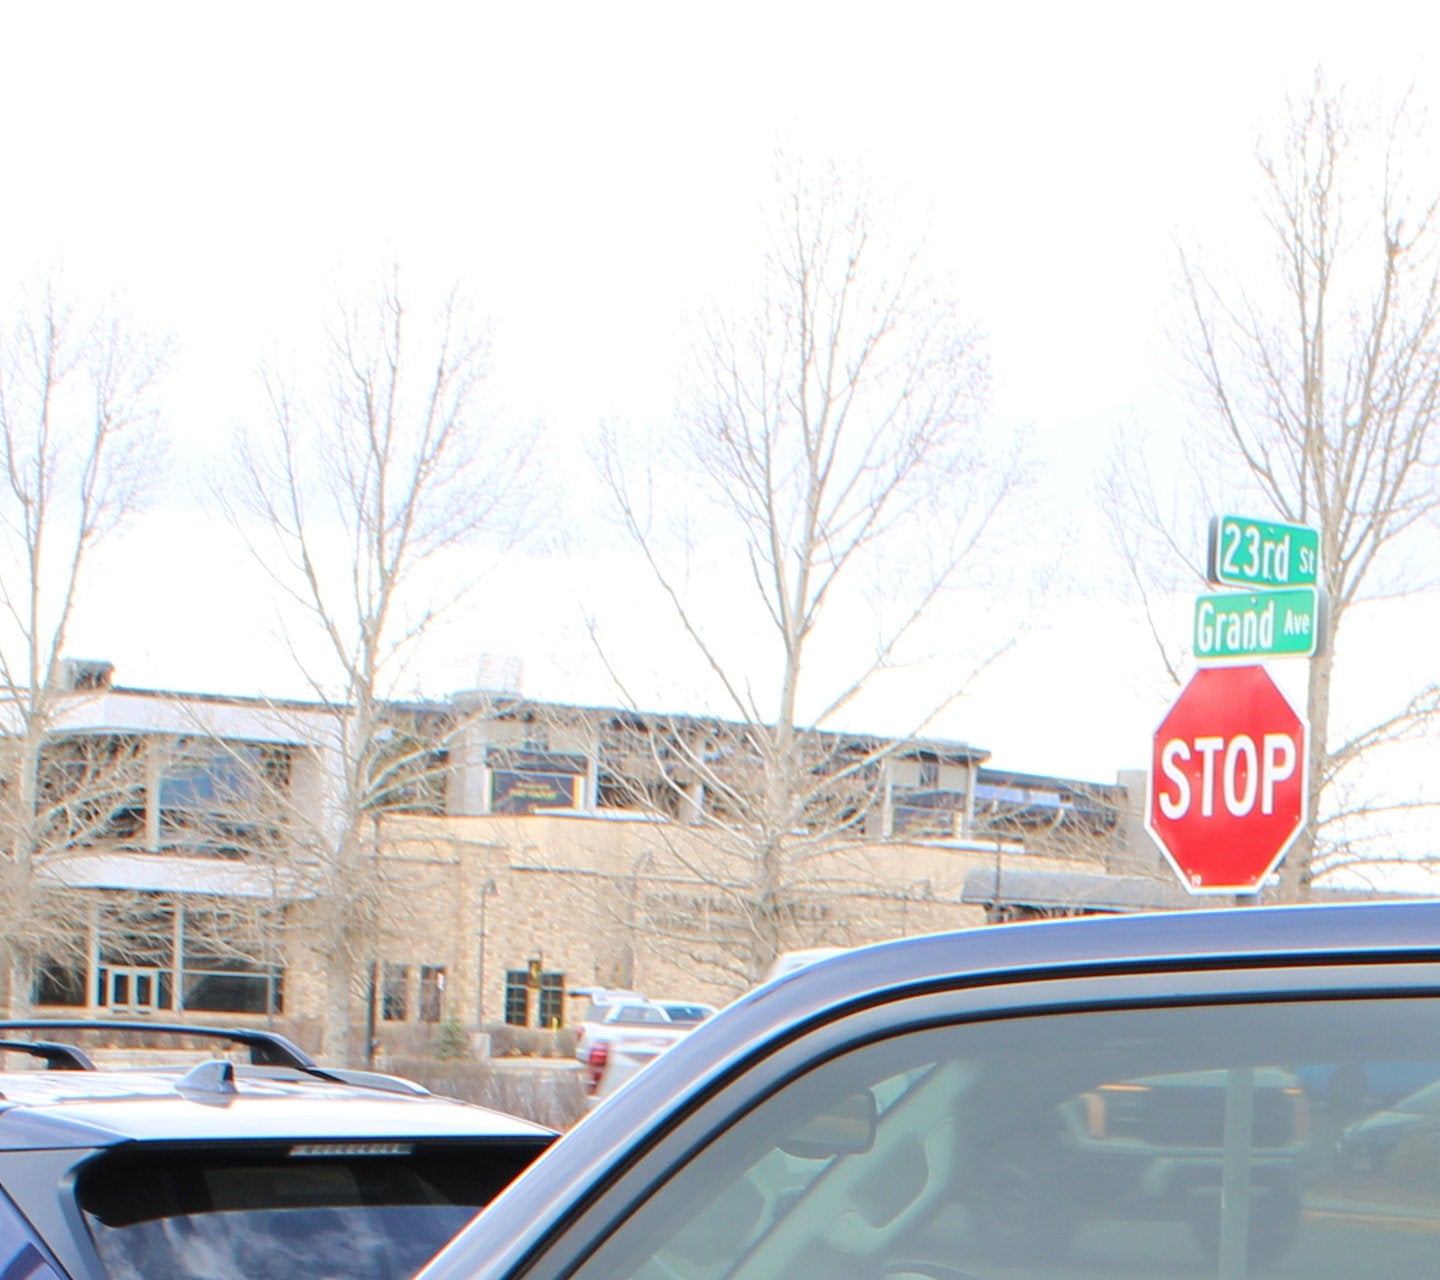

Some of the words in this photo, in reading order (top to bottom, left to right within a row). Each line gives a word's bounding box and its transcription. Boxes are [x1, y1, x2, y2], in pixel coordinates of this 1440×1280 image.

[1222, 522, 1290, 583] 23rd
[1299, 545, 1316, 576] St
[1197, 599, 1275, 654] Grand
[1283, 608, 1310, 637] Ave
[1159, 732, 1297, 820] STOP
